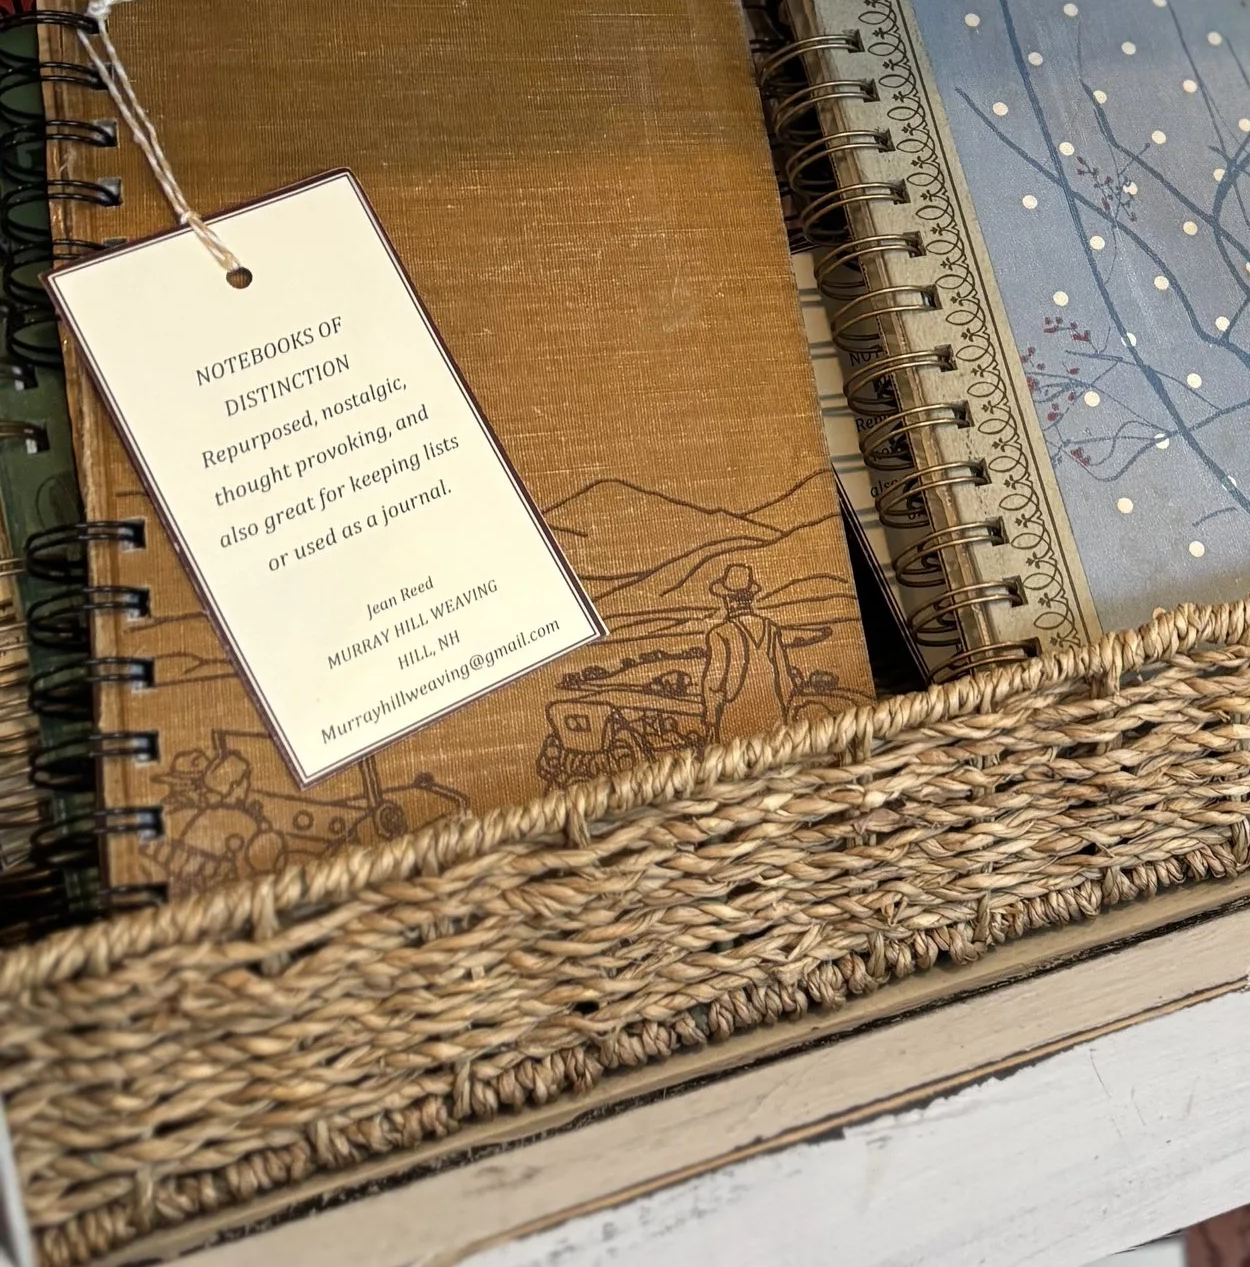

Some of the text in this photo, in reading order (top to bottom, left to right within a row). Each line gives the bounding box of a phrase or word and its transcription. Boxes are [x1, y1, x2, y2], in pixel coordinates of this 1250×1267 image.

[196, 317, 343, 386] NOTEBOOKS OF
[225, 354, 351, 416] DISTINCTION
[201, 377, 407, 468] Repurposed, nostalgic,
[215, 404, 429, 506] thought provoking, and
[220, 435, 460, 548] also great for keeping lists
[268, 479, 452, 571] or used as a journal.
[327, 580, 498, 669] MURRAY HILL WEAVING
[366, 576, 434, 620] Jean Reed
[321, 620, 560, 744] Murrayhillweaving@gmail.com
[398, 630, 461, 670] HILL, NH
